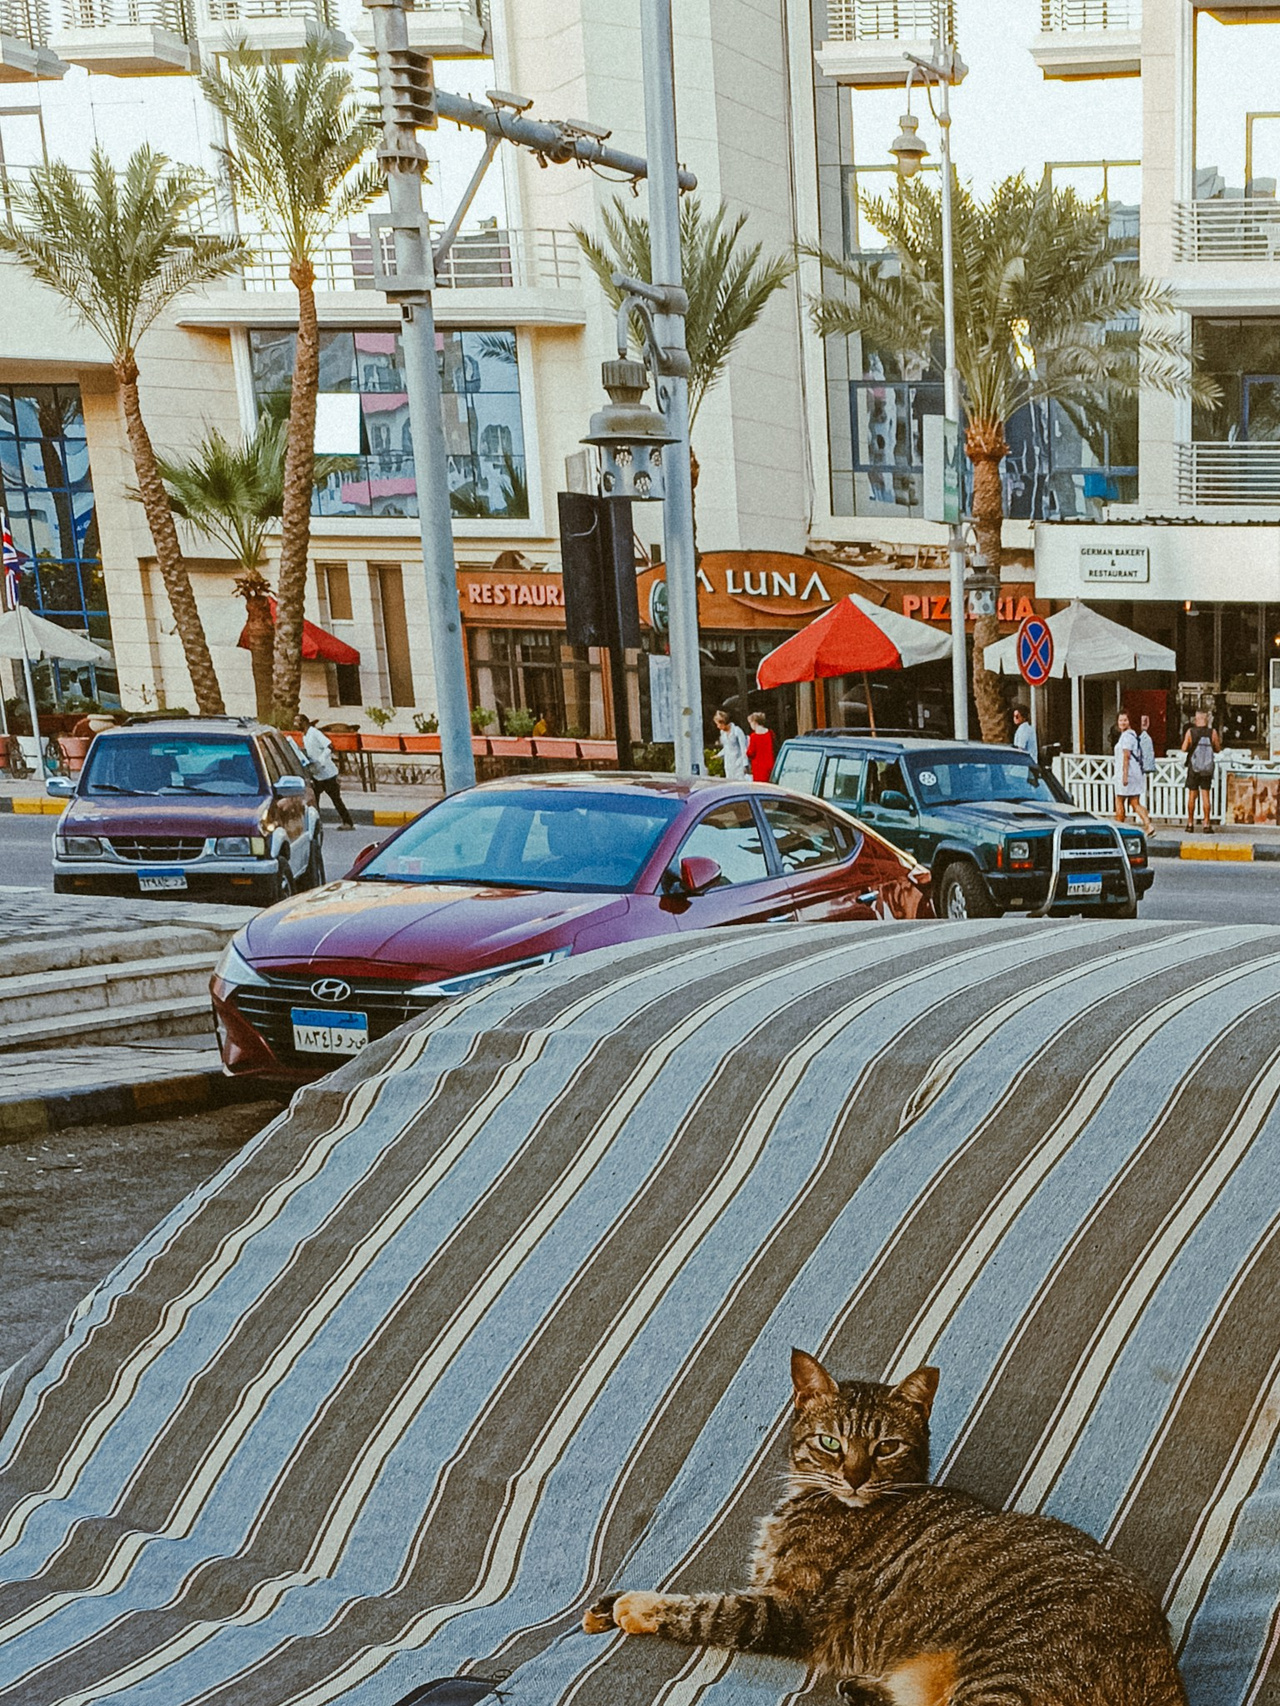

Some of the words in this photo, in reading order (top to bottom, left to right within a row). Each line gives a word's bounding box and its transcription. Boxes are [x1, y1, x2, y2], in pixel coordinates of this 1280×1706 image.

[1081, 548, 1113, 556] GERMAN
[1115, 548, 1145, 556] BAKERY
[1089, 570, 1138, 578] RESTAURANT
[725, 569, 831, 602] LUNA
[468, 583, 565, 607] RESTAUR
